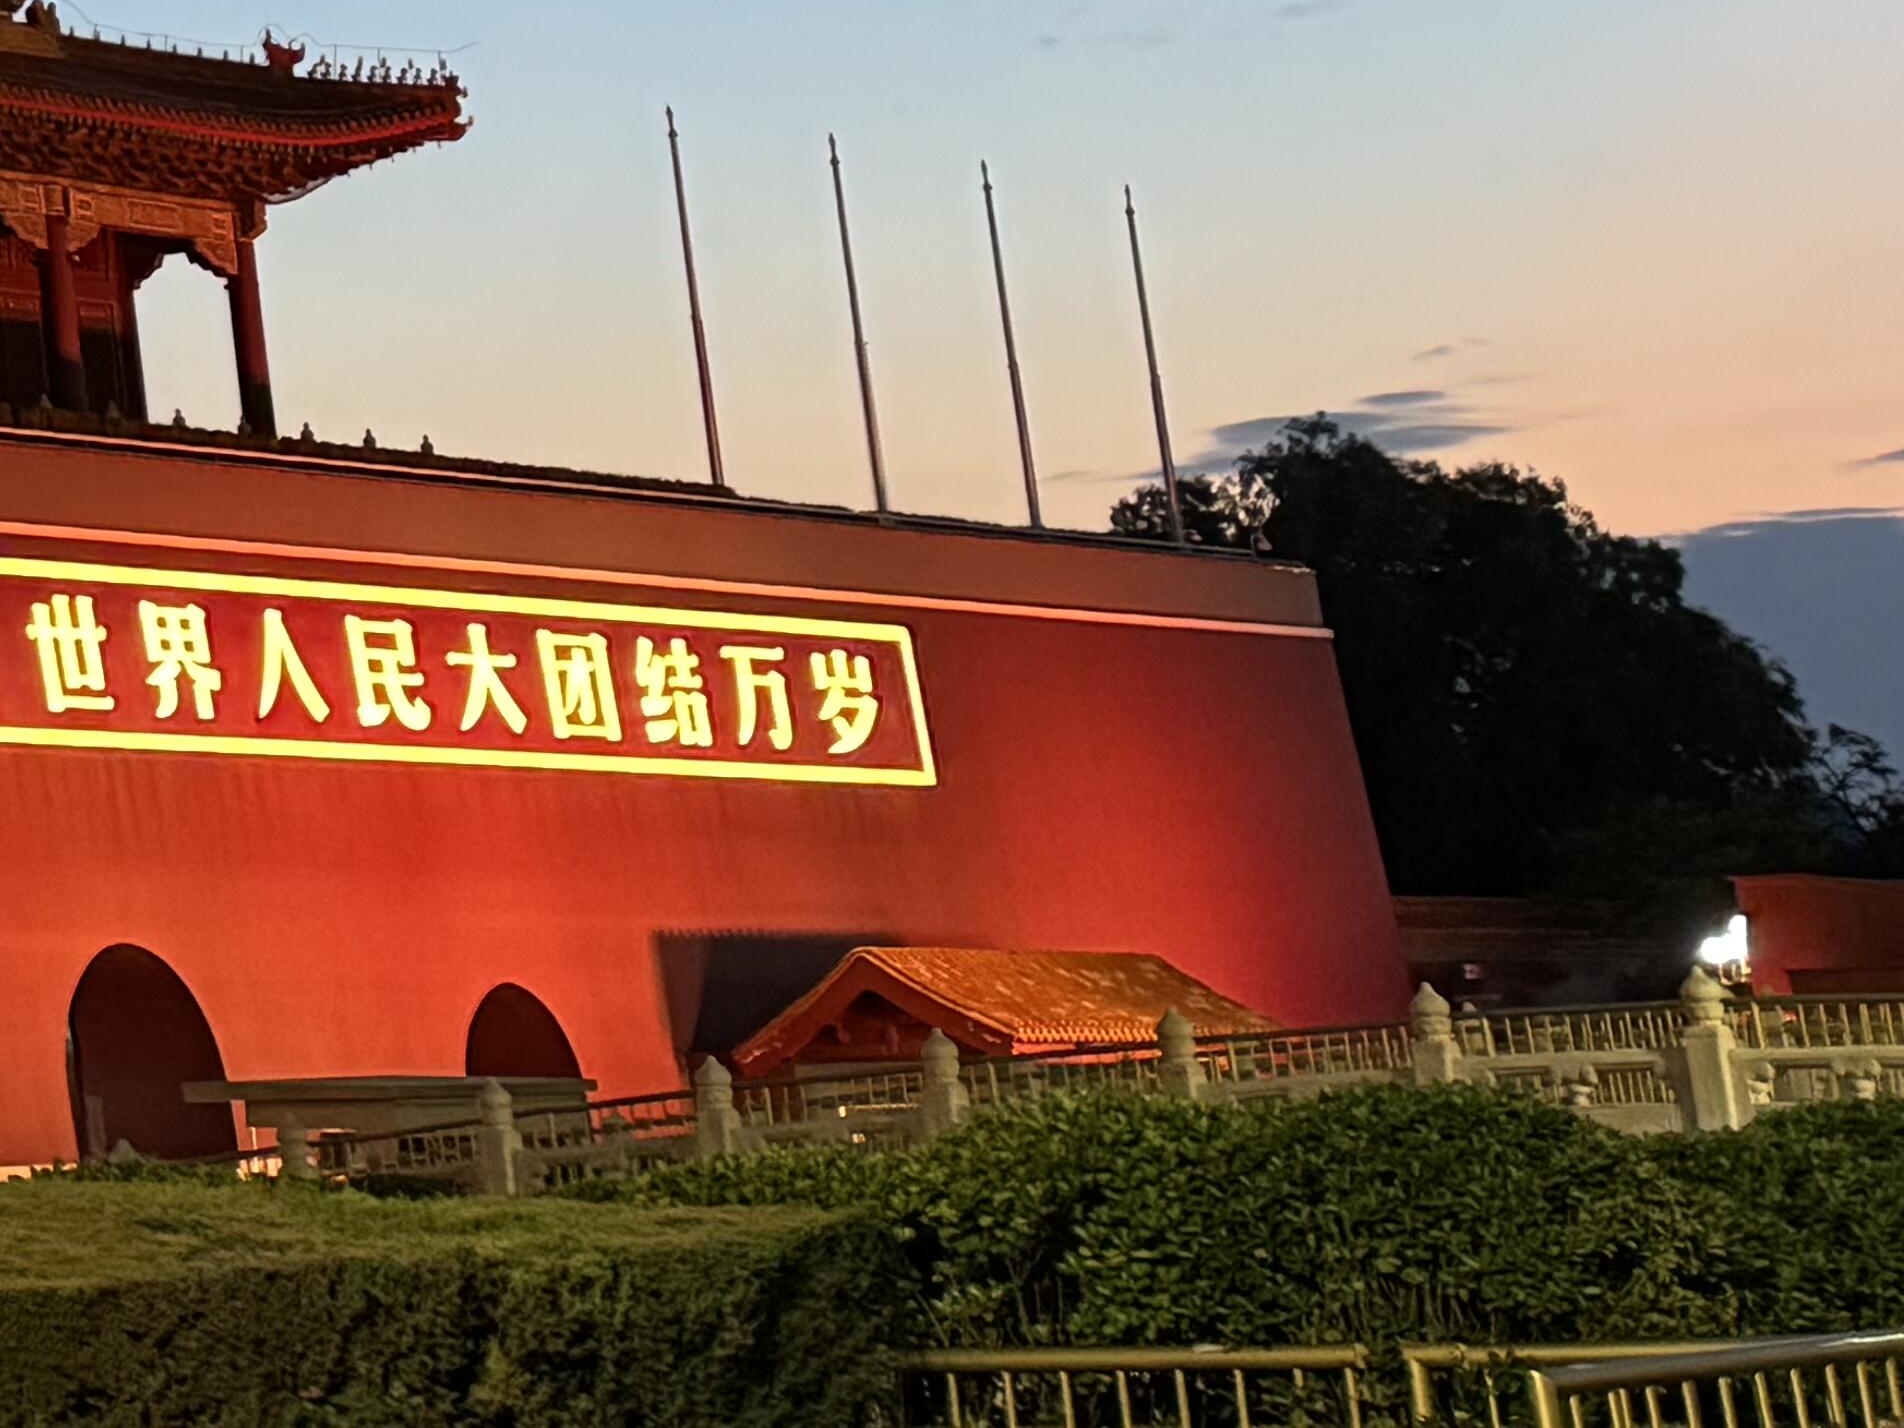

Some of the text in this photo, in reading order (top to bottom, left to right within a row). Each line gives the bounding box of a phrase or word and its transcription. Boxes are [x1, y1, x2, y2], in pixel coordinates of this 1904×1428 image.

[25, 593, 880, 755] 世界人民大团结万岁
